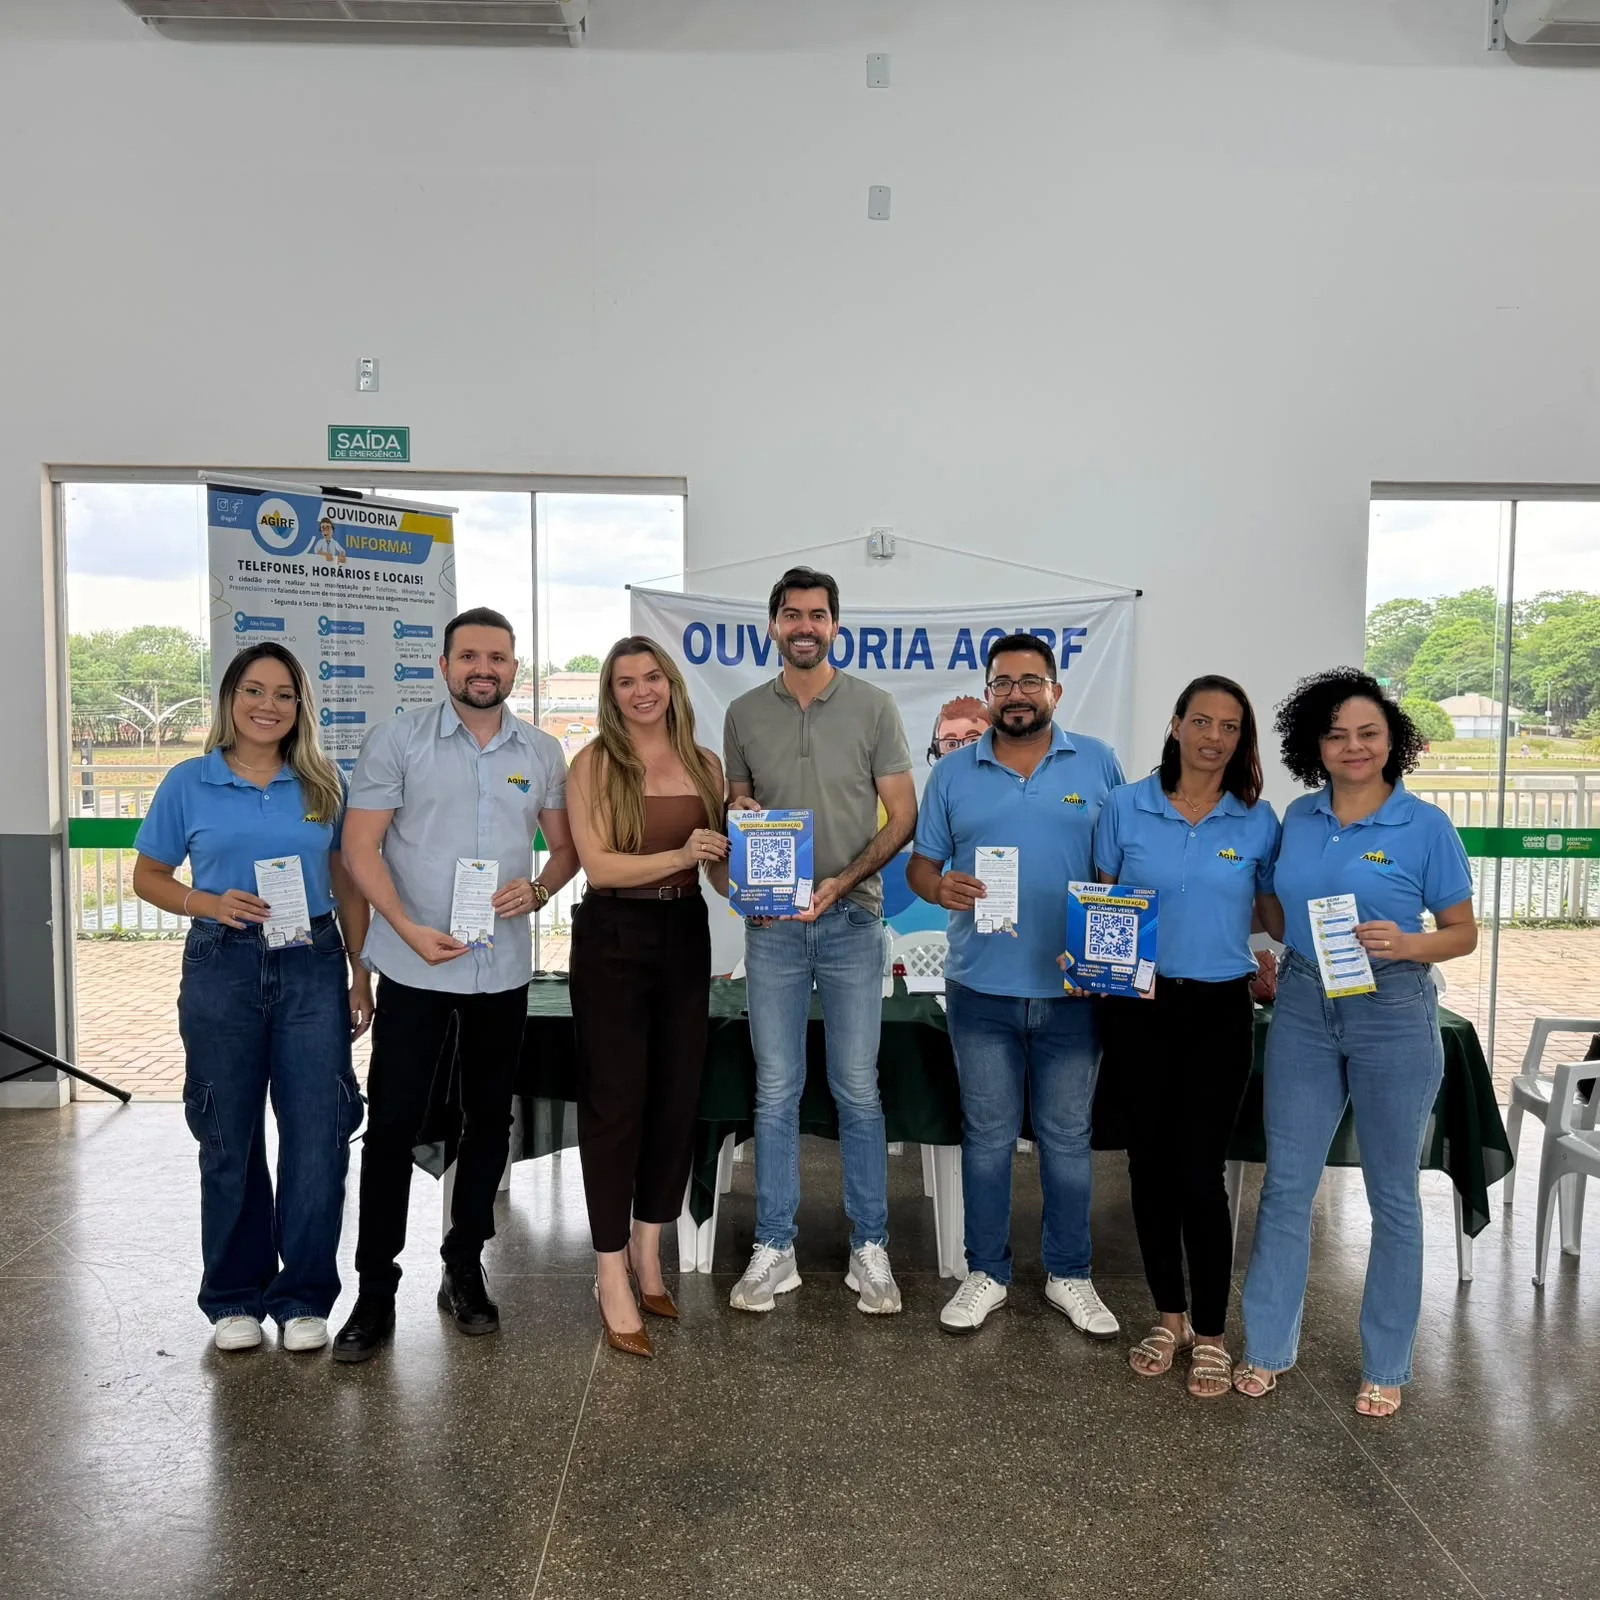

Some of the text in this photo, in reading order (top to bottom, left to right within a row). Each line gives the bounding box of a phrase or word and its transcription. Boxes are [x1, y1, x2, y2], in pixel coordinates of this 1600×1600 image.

[337, 429, 400, 449] SAÍDA
[260, 515, 295, 529] AGIRF
[326, 506, 397, 527] OUVIDORIA
[345, 534, 412, 555] INFORMA!
[238, 559, 423, 585] TELEFONES, HORÁRIOS E LOCAIS!
[229, 584, 277, 593] Presencialmente
[277, 587, 298, 595] falando
[324, 582, 358, 591] manifestação
[274, 599, 297, 607] Segunda
[683, 622, 1088, 670] OUVORIA AGF
[508, 777, 530, 785] AGIRF
[1063, 797, 1087, 805] AGIRF
[1218, 852, 1244, 862] AGIRF
[1362, 854, 1395, 866] AGIRF
[1113, 898, 1146, 907] SATISFAÇÃO
